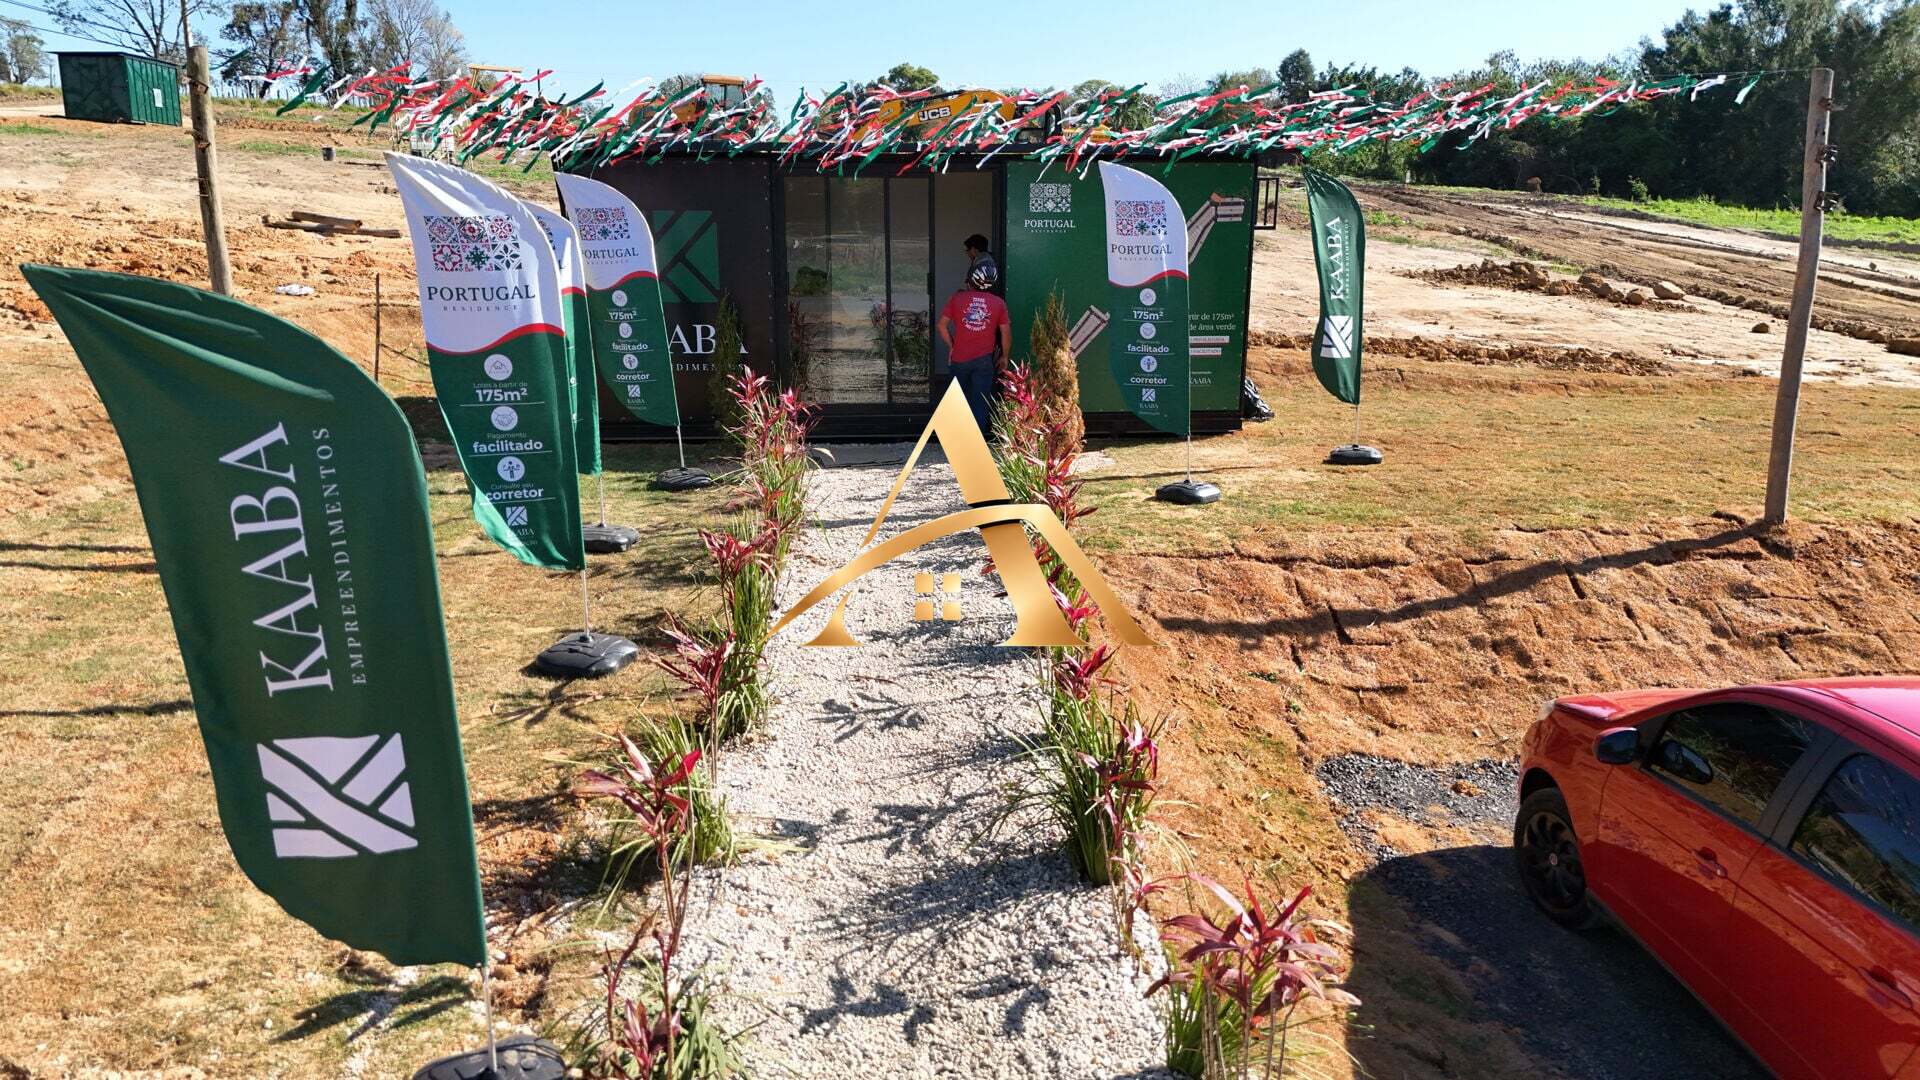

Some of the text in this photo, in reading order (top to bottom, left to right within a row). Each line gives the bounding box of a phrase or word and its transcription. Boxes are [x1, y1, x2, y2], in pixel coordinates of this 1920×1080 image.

[918, 107, 950, 121] JCB
[1024, 218, 1076, 228] PORTUGAL
[1111, 243, 1173, 256] PORTUGAL
[1326, 216, 1344, 300] KAABA
[427, 284, 536, 302] PORTUGAL
[443, 304, 518, 312] RESIDENCE
[1132, 310, 1164, 320] 175m²
[1215, 322, 1237, 331] verde
[1127, 344, 1169, 353] facilitado
[1130, 376, 1167, 384] corretor
[475, 387, 528, 402] 175m²
[472, 439, 543, 453] facilitado
[485, 487, 544, 501] corretor
[218, 421, 334, 698] KAABA
[313, 427, 367, 685] EMPREENDIMENTOS
